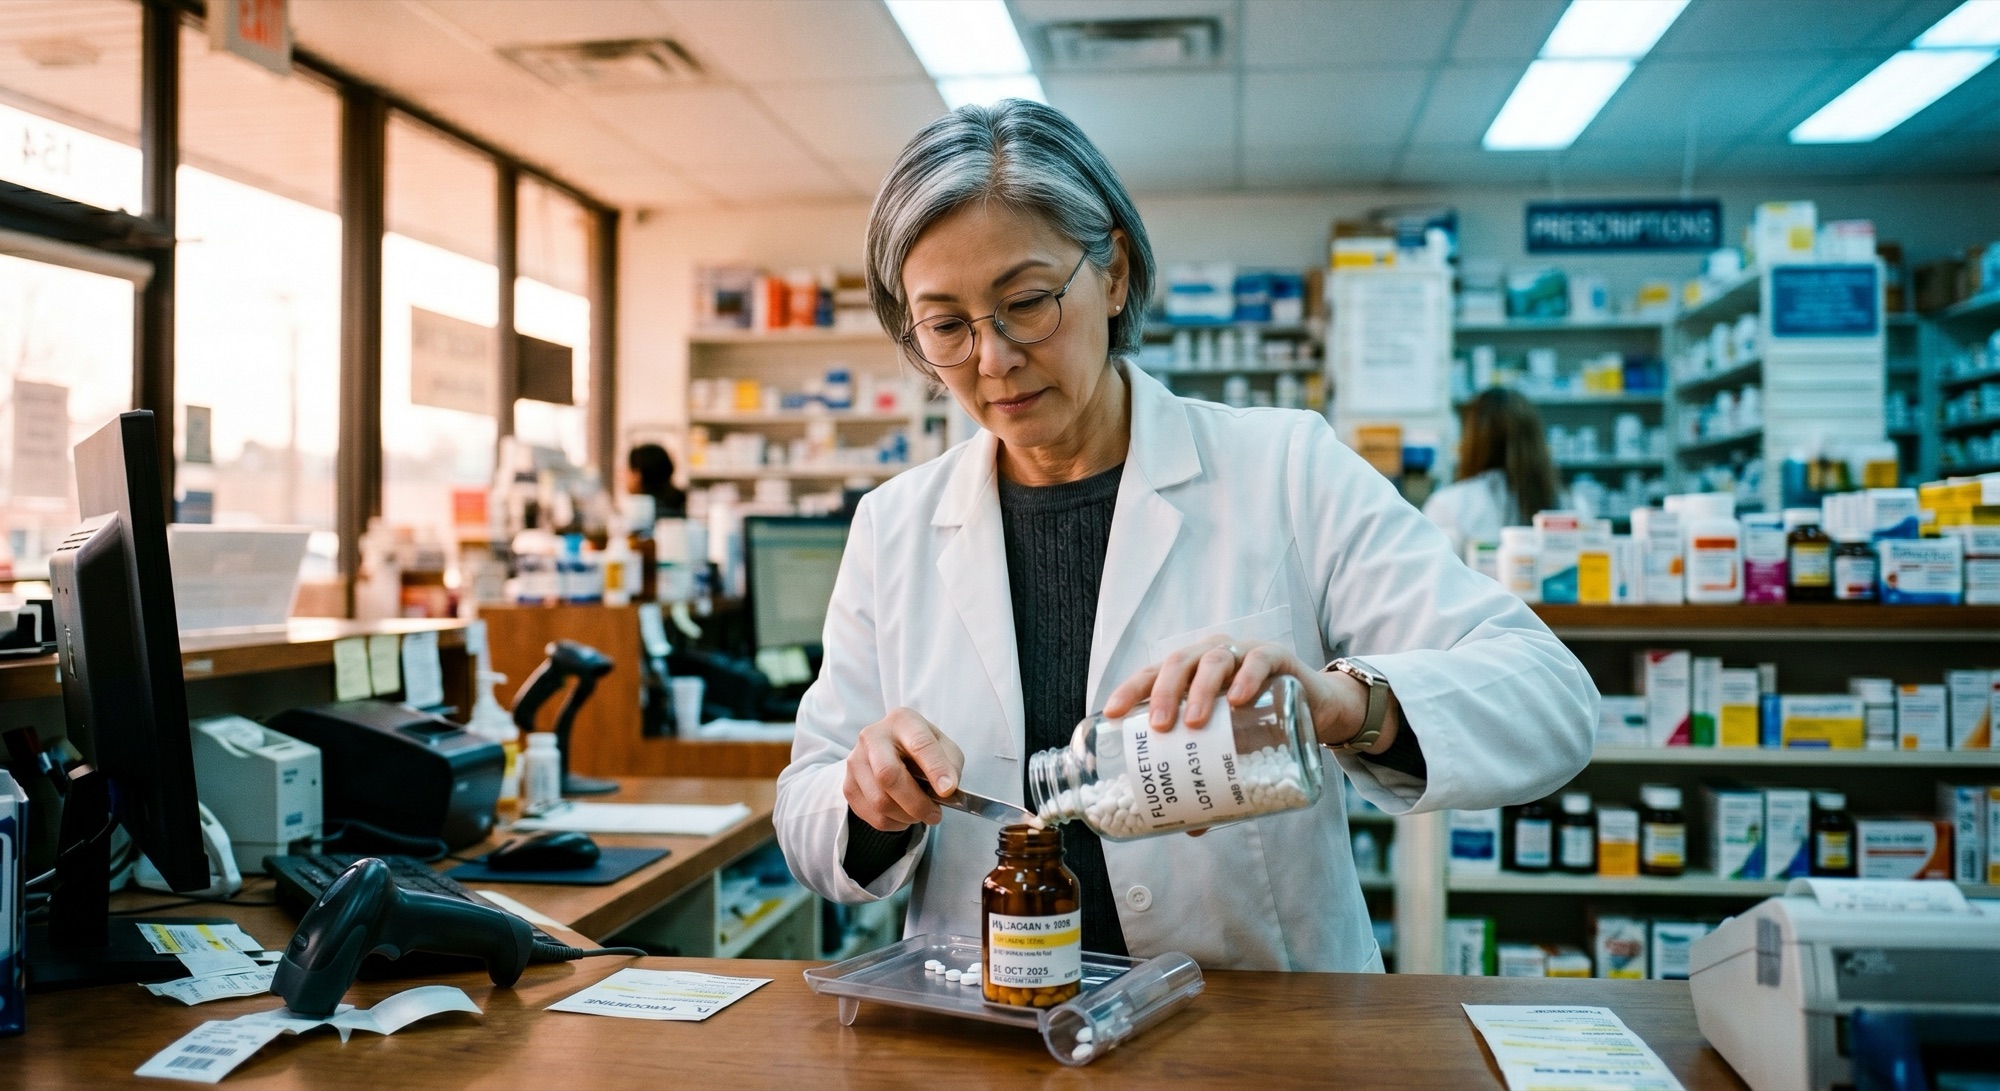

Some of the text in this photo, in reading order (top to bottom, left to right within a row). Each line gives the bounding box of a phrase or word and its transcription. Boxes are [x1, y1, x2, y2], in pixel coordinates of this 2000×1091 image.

[1136, 731, 1165, 818] FLUOXETINE
[1157, 761, 1178, 804] 30MG
[1004, 966, 1024, 975] OCT
[1026, 966, 1049, 976] 2025
